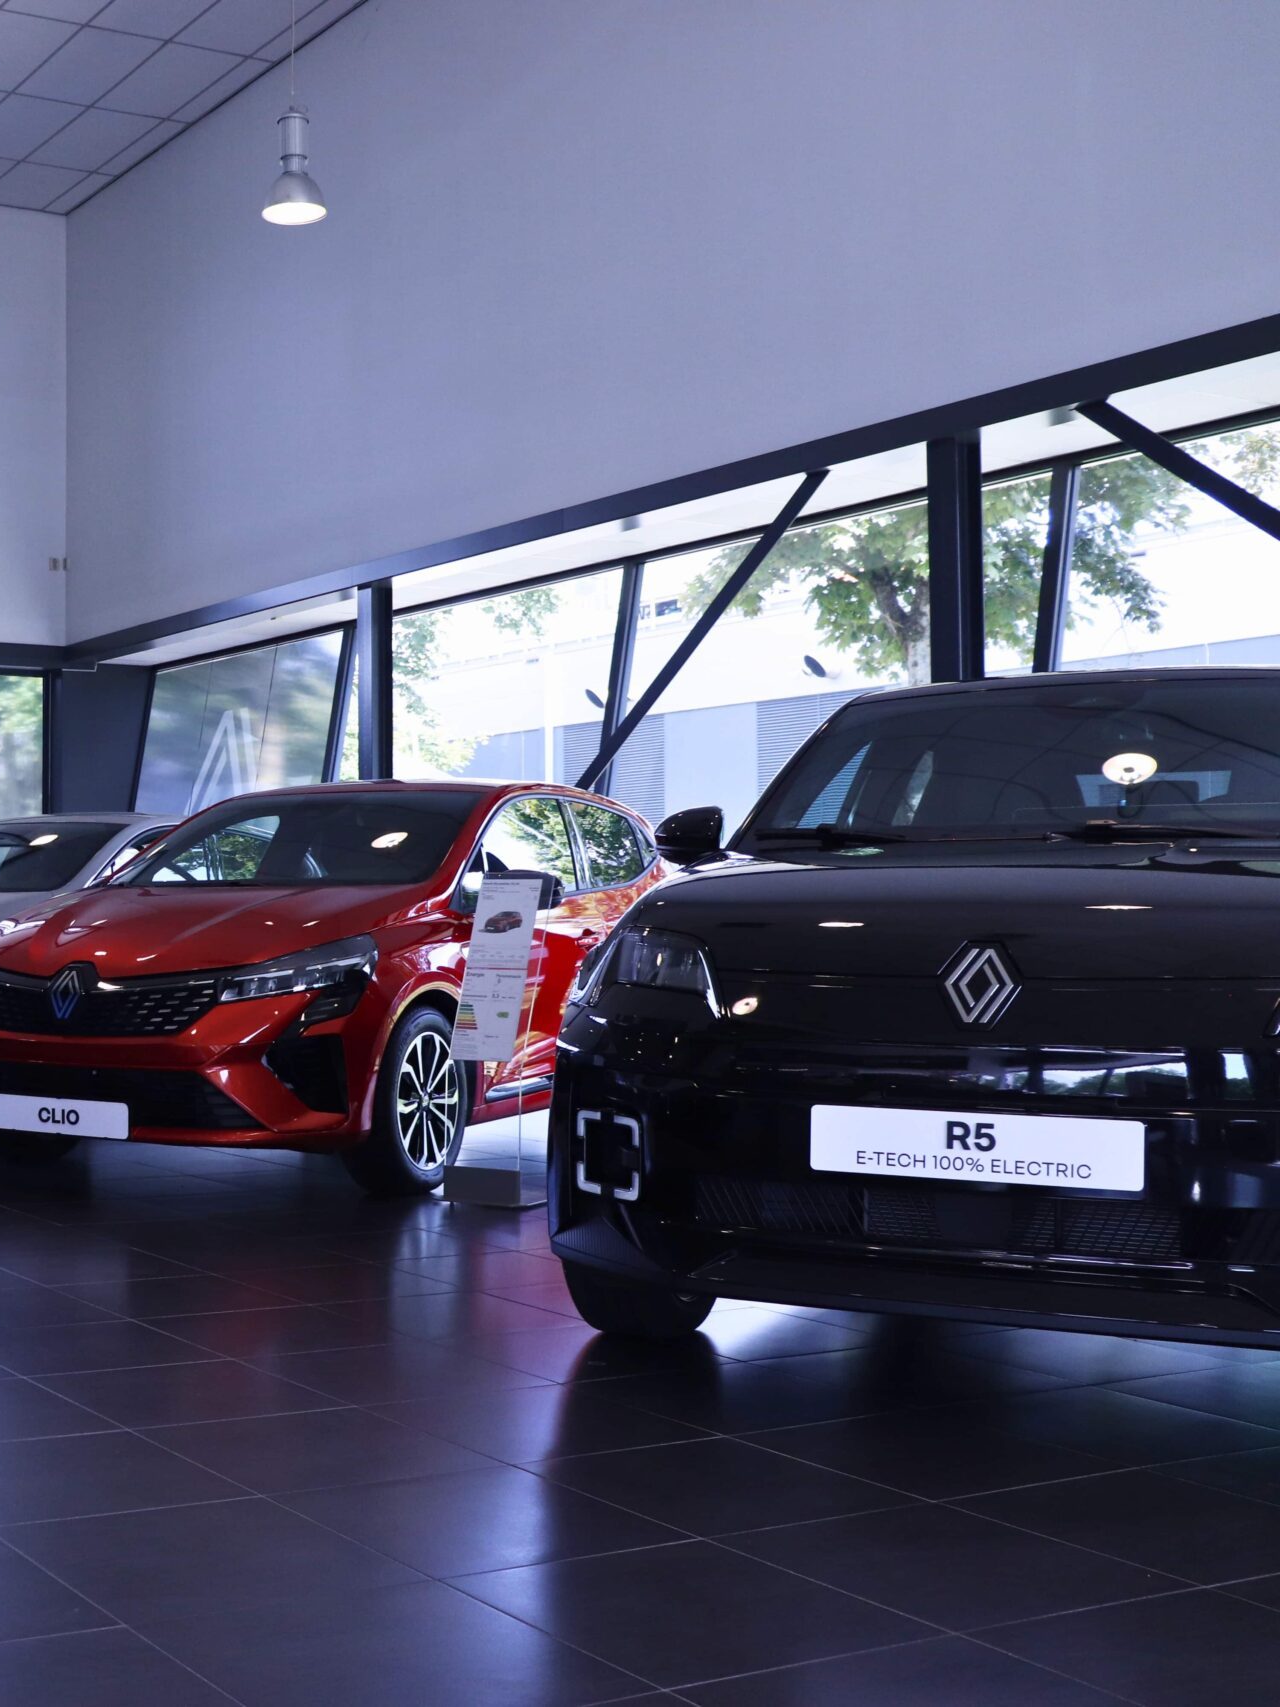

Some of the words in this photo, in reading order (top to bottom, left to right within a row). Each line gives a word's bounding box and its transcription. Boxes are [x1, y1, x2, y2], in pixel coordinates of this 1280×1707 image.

[38, 1107, 80, 1125] CLIO
[945, 1120, 996, 1152] R5
[856, 1150, 926, 1169] E-TECH
[932, 1154, 985, 1173] 100%
[991, 1158, 1092, 1180] ELECTRIC
